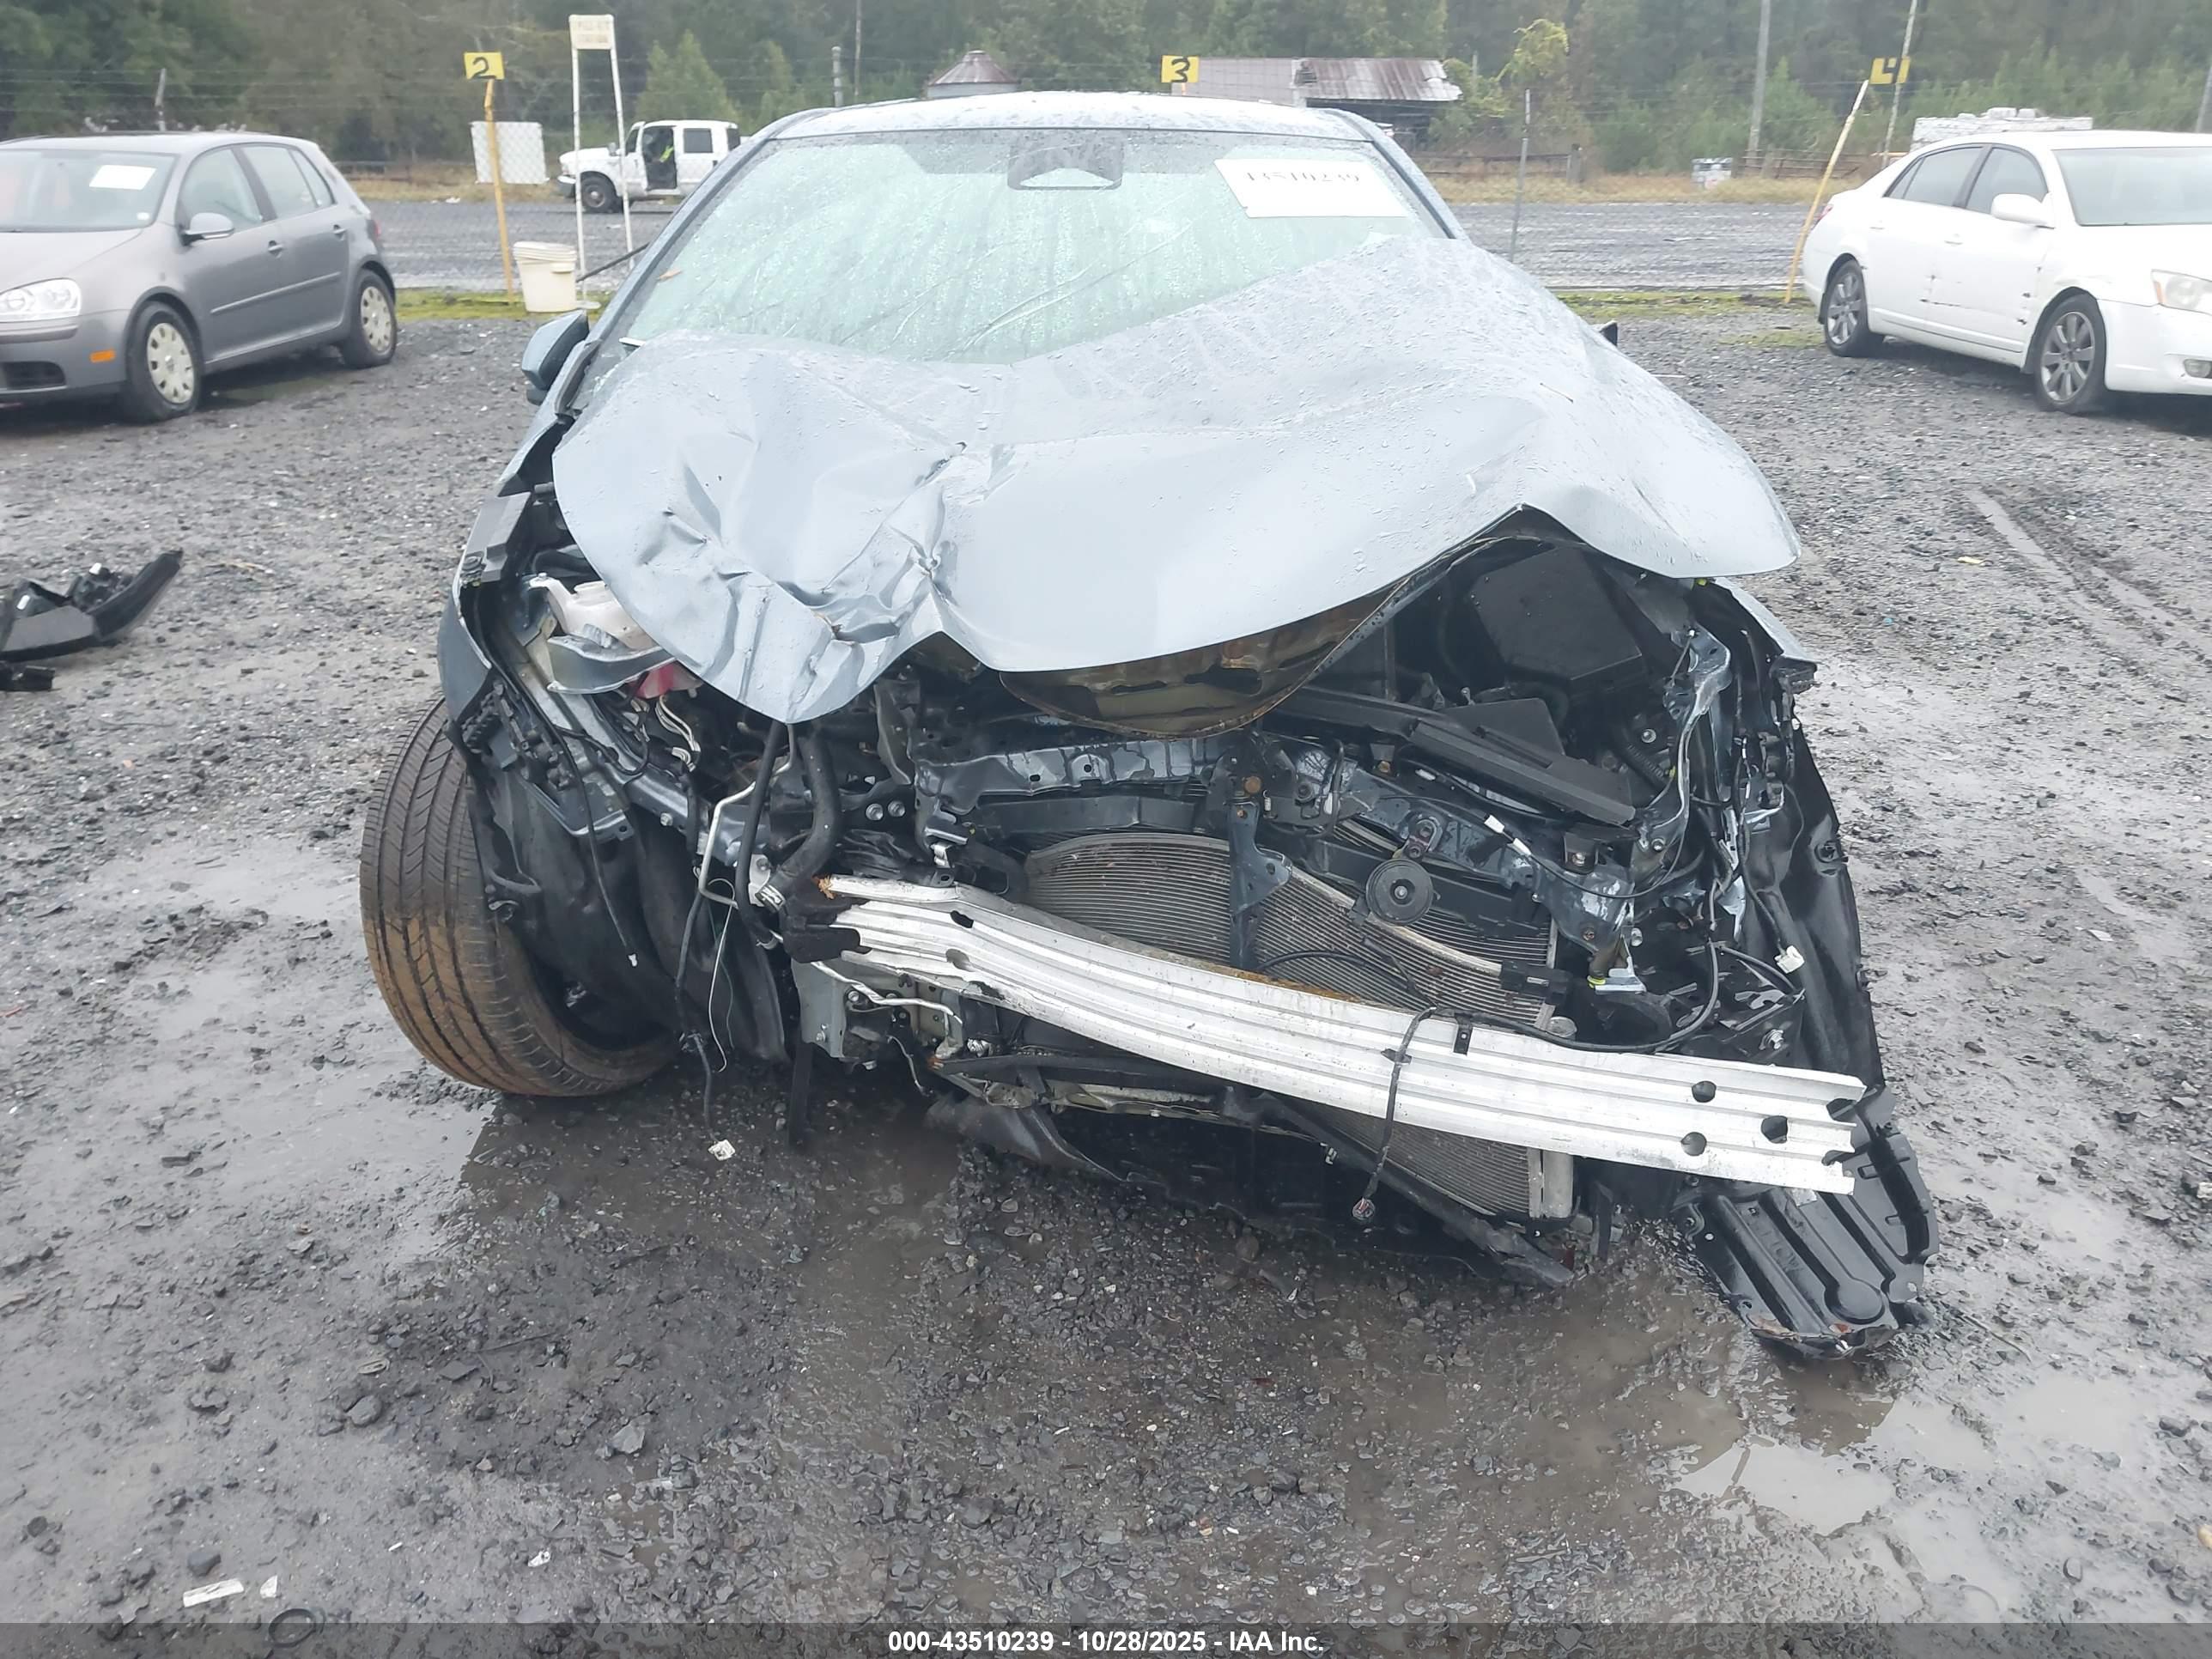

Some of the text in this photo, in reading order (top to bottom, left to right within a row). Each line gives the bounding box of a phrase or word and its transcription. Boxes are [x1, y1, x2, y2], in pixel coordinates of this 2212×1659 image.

[472, 57, 496, 79] 2
[1170, 57, 1190, 82] 3
[1881, 57, 1901, 84] 4
